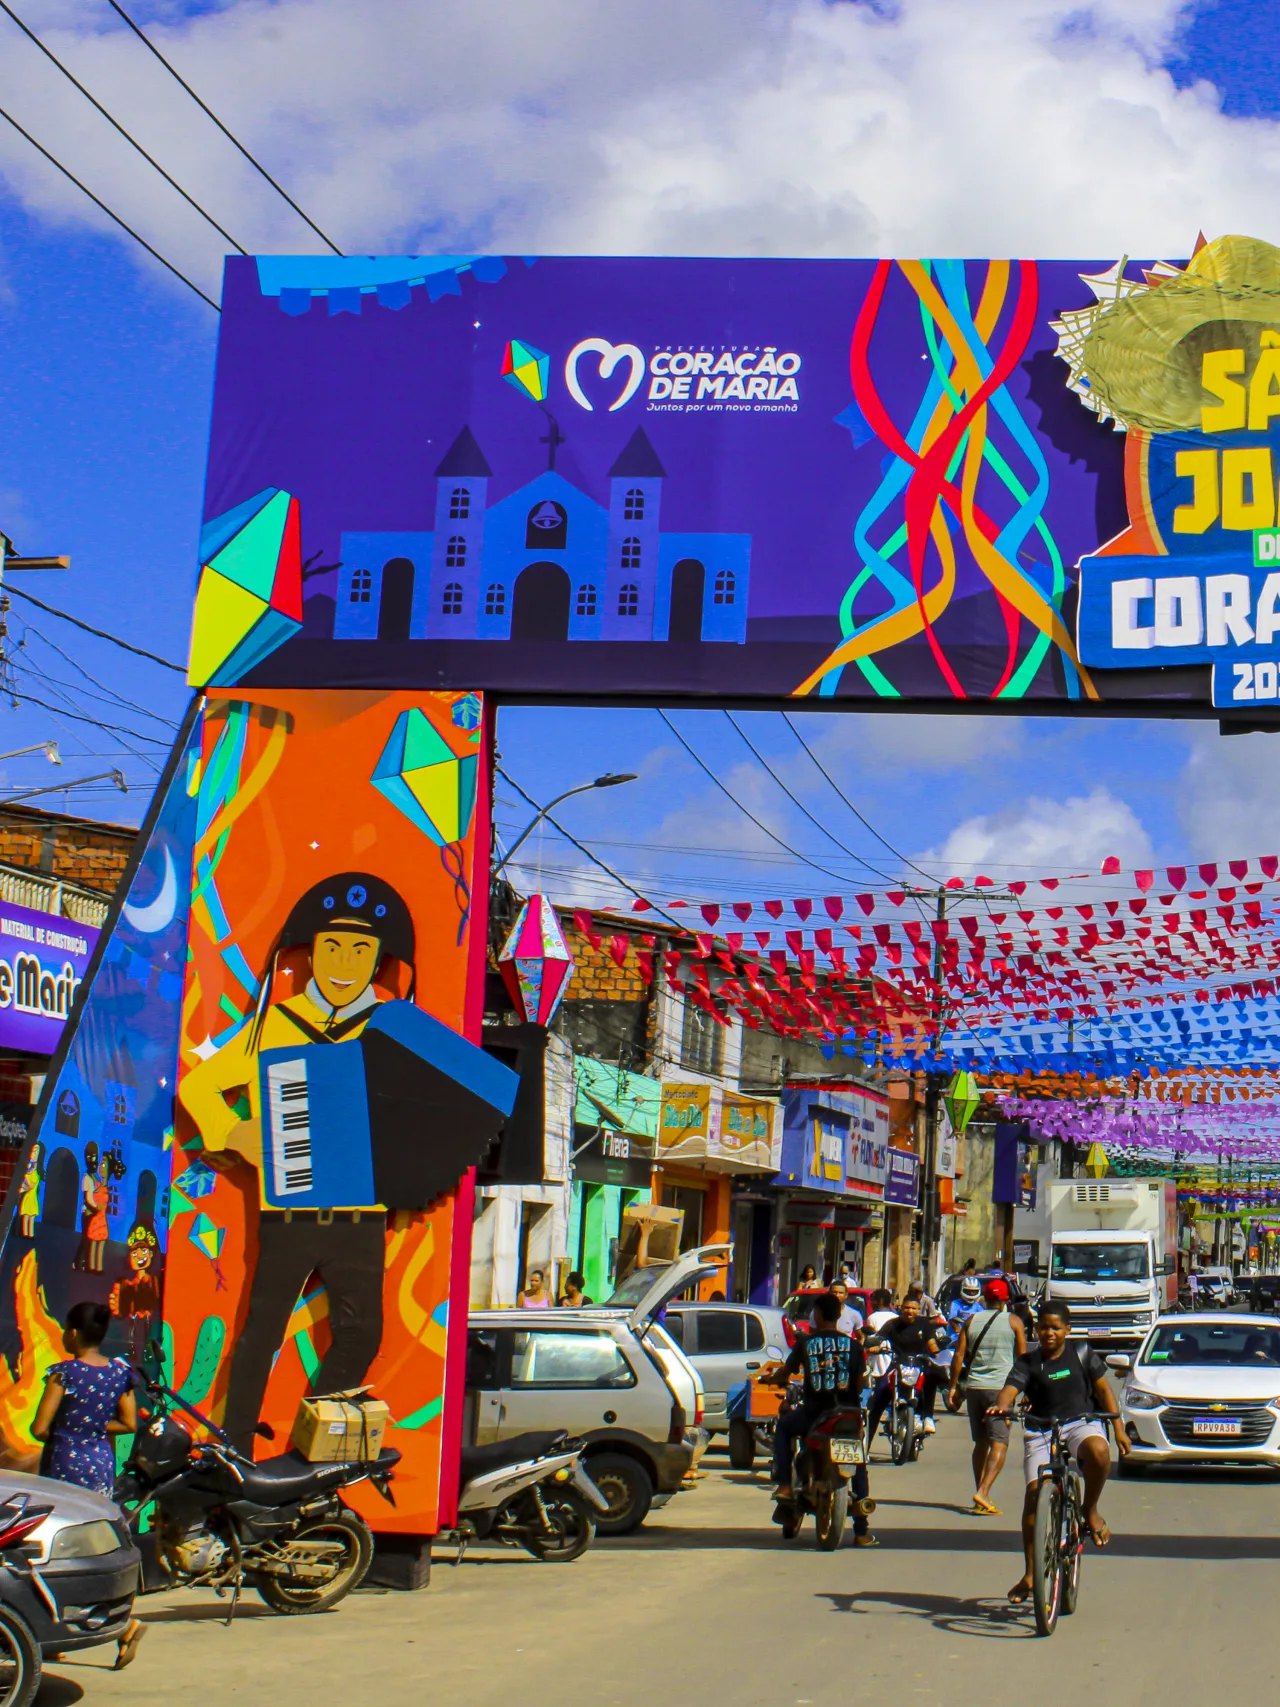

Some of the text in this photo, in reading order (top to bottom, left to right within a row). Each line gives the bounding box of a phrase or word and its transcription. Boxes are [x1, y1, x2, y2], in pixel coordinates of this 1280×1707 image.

[650, 347, 802, 380] CORAÇÃO
[648, 377, 799, 400] DE MARIA
[646, 403, 683, 411] Juntos
[686, 404, 704, 413] por
[754, 403, 798, 412] amanhã
[1, 918, 88, 956] MATERIAL DE CONSTRUÇÃO
